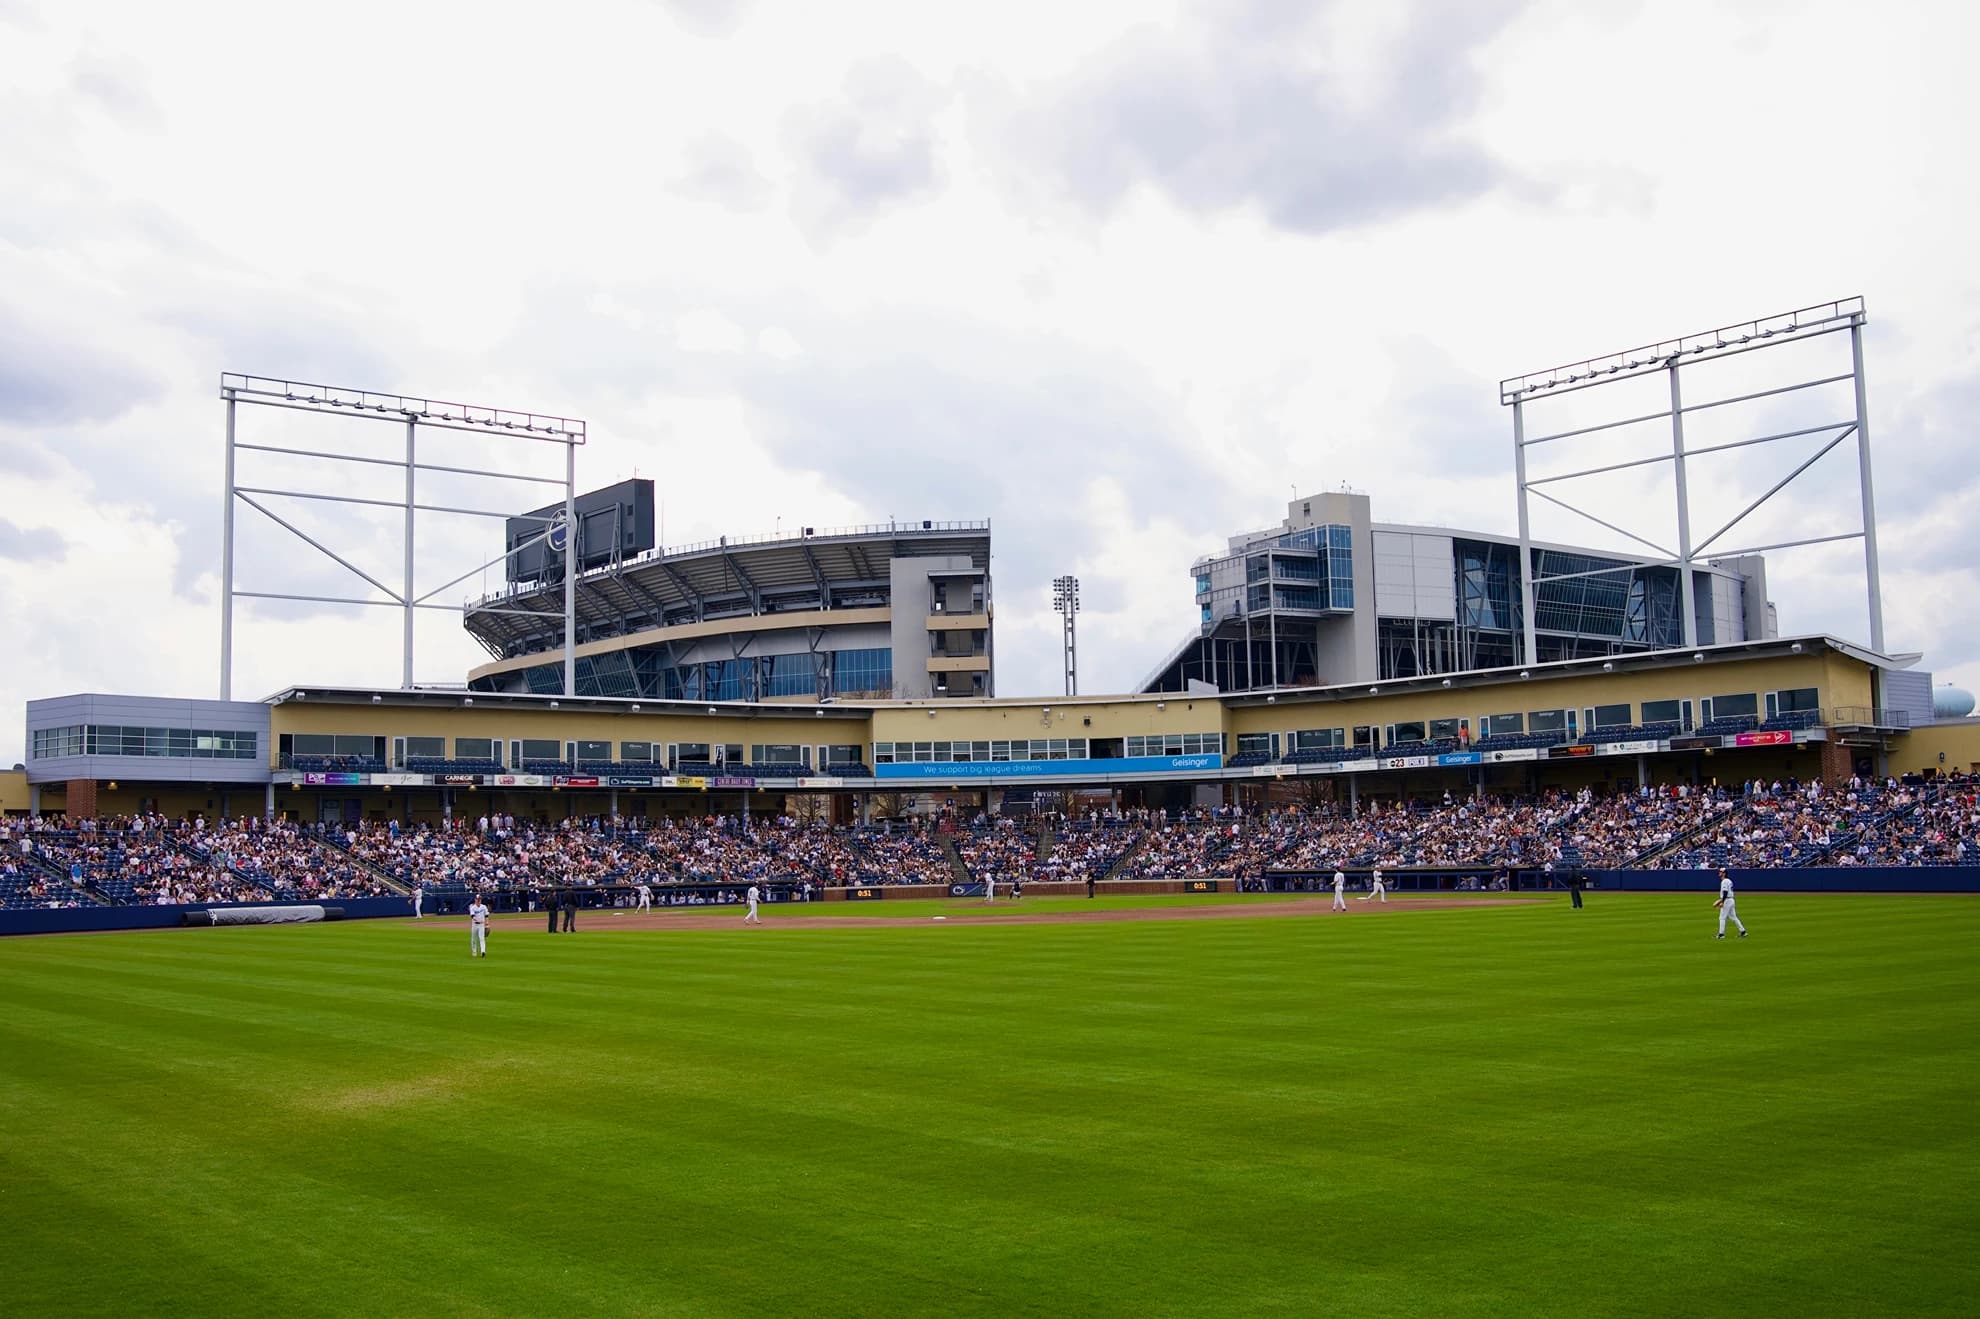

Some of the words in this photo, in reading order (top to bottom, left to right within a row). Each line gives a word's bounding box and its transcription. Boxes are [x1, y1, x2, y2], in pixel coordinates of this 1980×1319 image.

[1172, 758, 1209, 768] Geisinger
[1395, 758, 1405, 768] 23
[1445, 755, 1472, 764] Geisinger
[923, 765, 937, 774] We
[938, 765, 968, 775] support
[970, 764, 982, 775] big
[985, 763, 1011, 774] league
[1013, 763, 1042, 772] dreams
